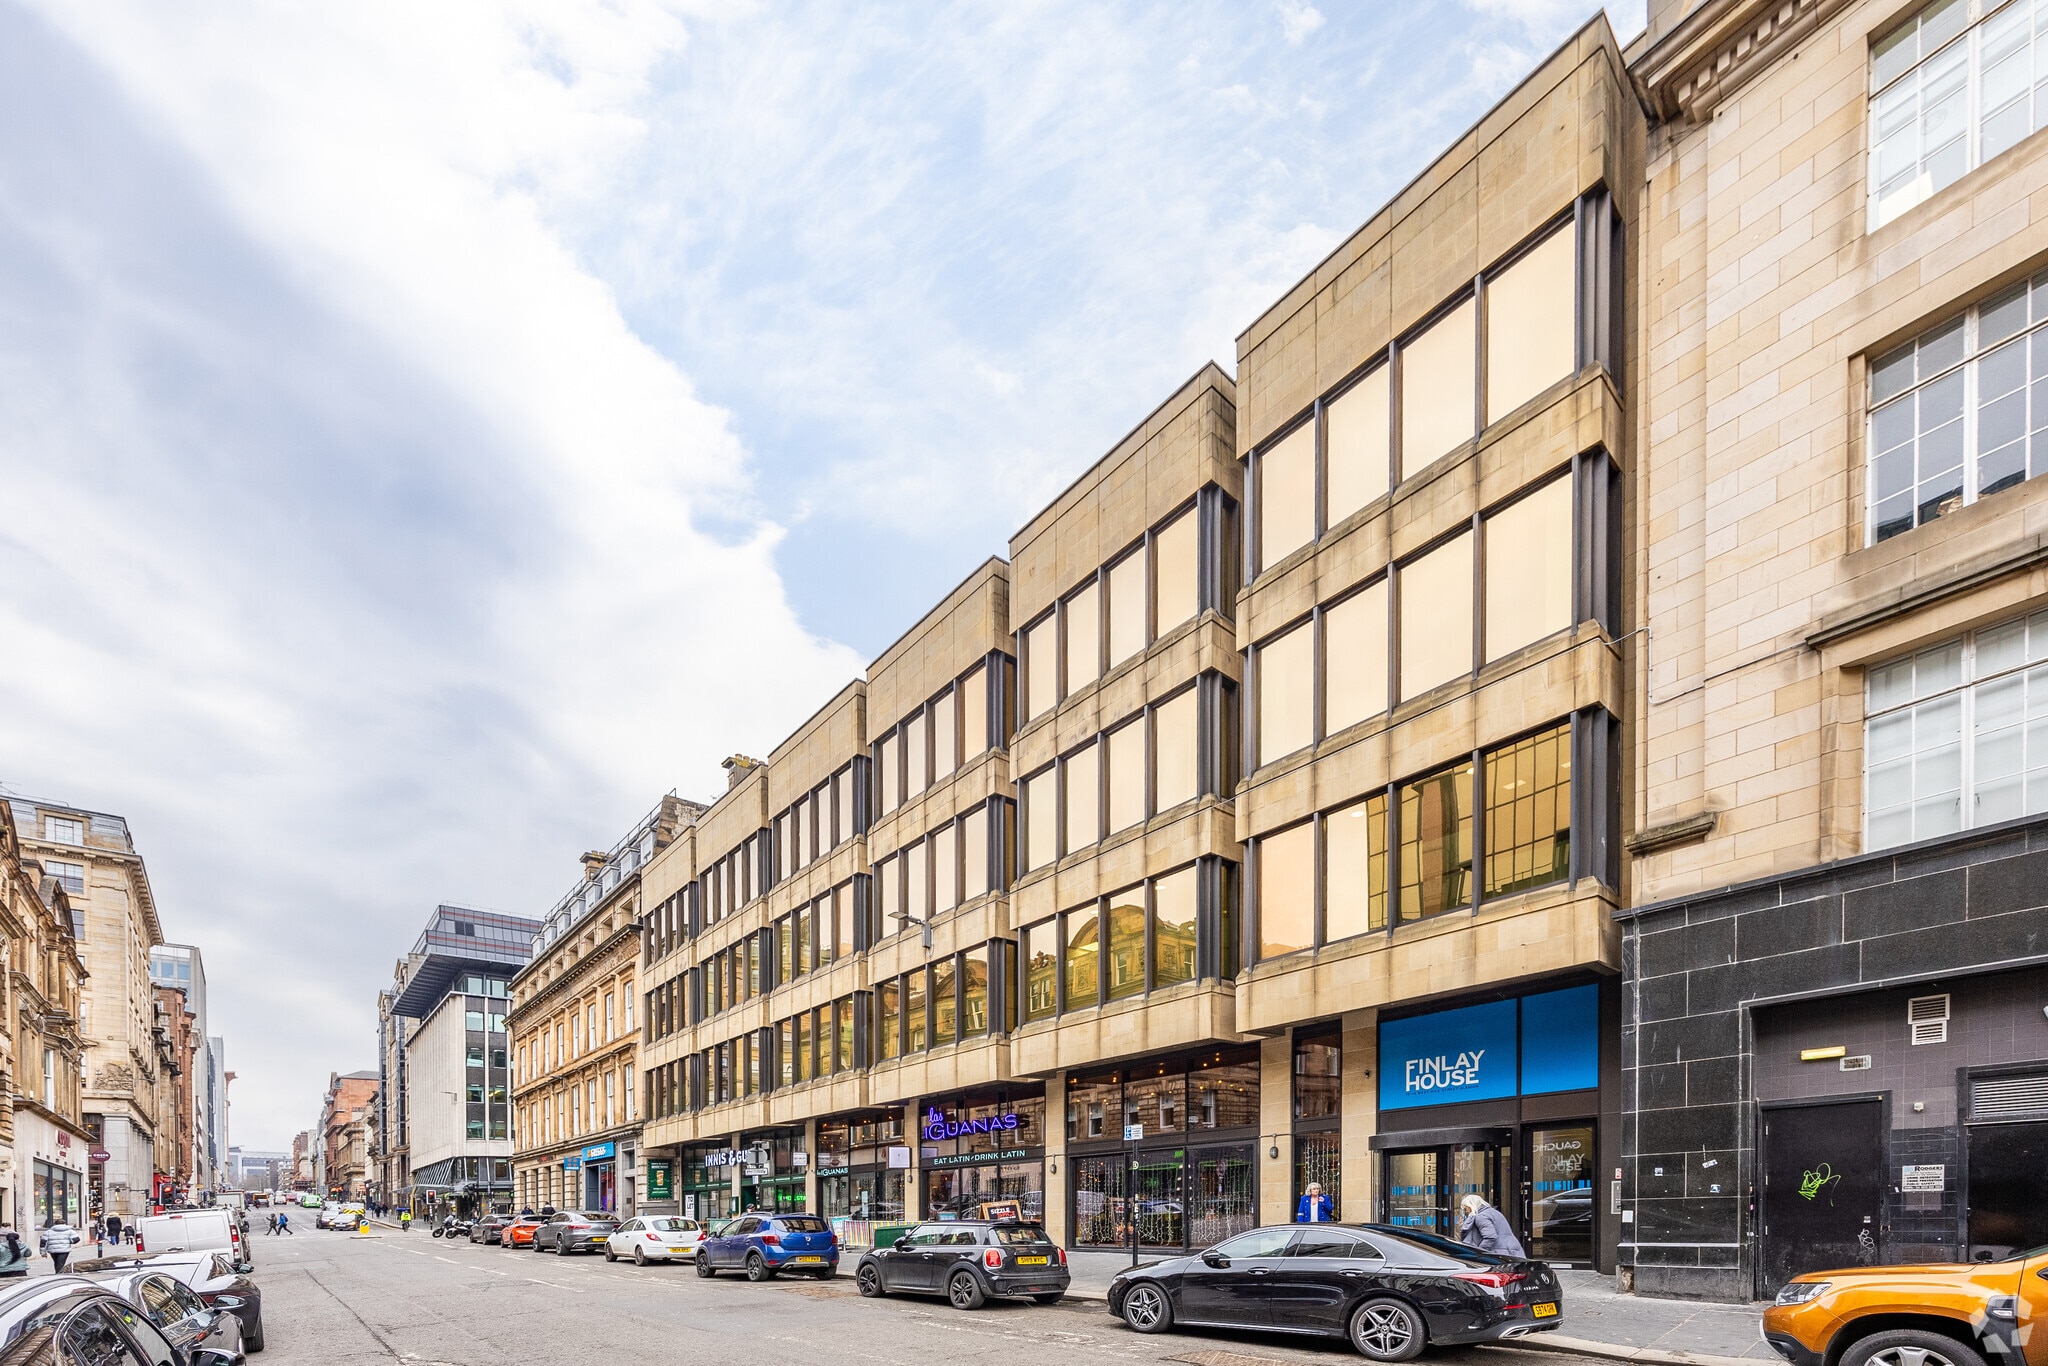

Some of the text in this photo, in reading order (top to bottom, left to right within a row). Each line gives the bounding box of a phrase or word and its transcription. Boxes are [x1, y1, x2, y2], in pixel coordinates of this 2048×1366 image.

[1406, 1049, 1485, 1075] FINLAY
[1406, 1068, 1479, 1092] HOUSE
[928, 1107, 943, 1122] las
[924, 1114, 1018, 1140] IGUANAS
[705, 1152, 727, 1167] INNIS
[728, 1150, 736, 1166] &
[949, 1155, 970, 1163] LATIN
[975, 1152, 999, 1161] DRINK
[1001, 1150, 1026, 1158] LATIN
[1428, 1153, 1432, 1162] 3
[820, 1167, 849, 1177] IGUANAS
[1428, 1165, 1432, 1173] 2
